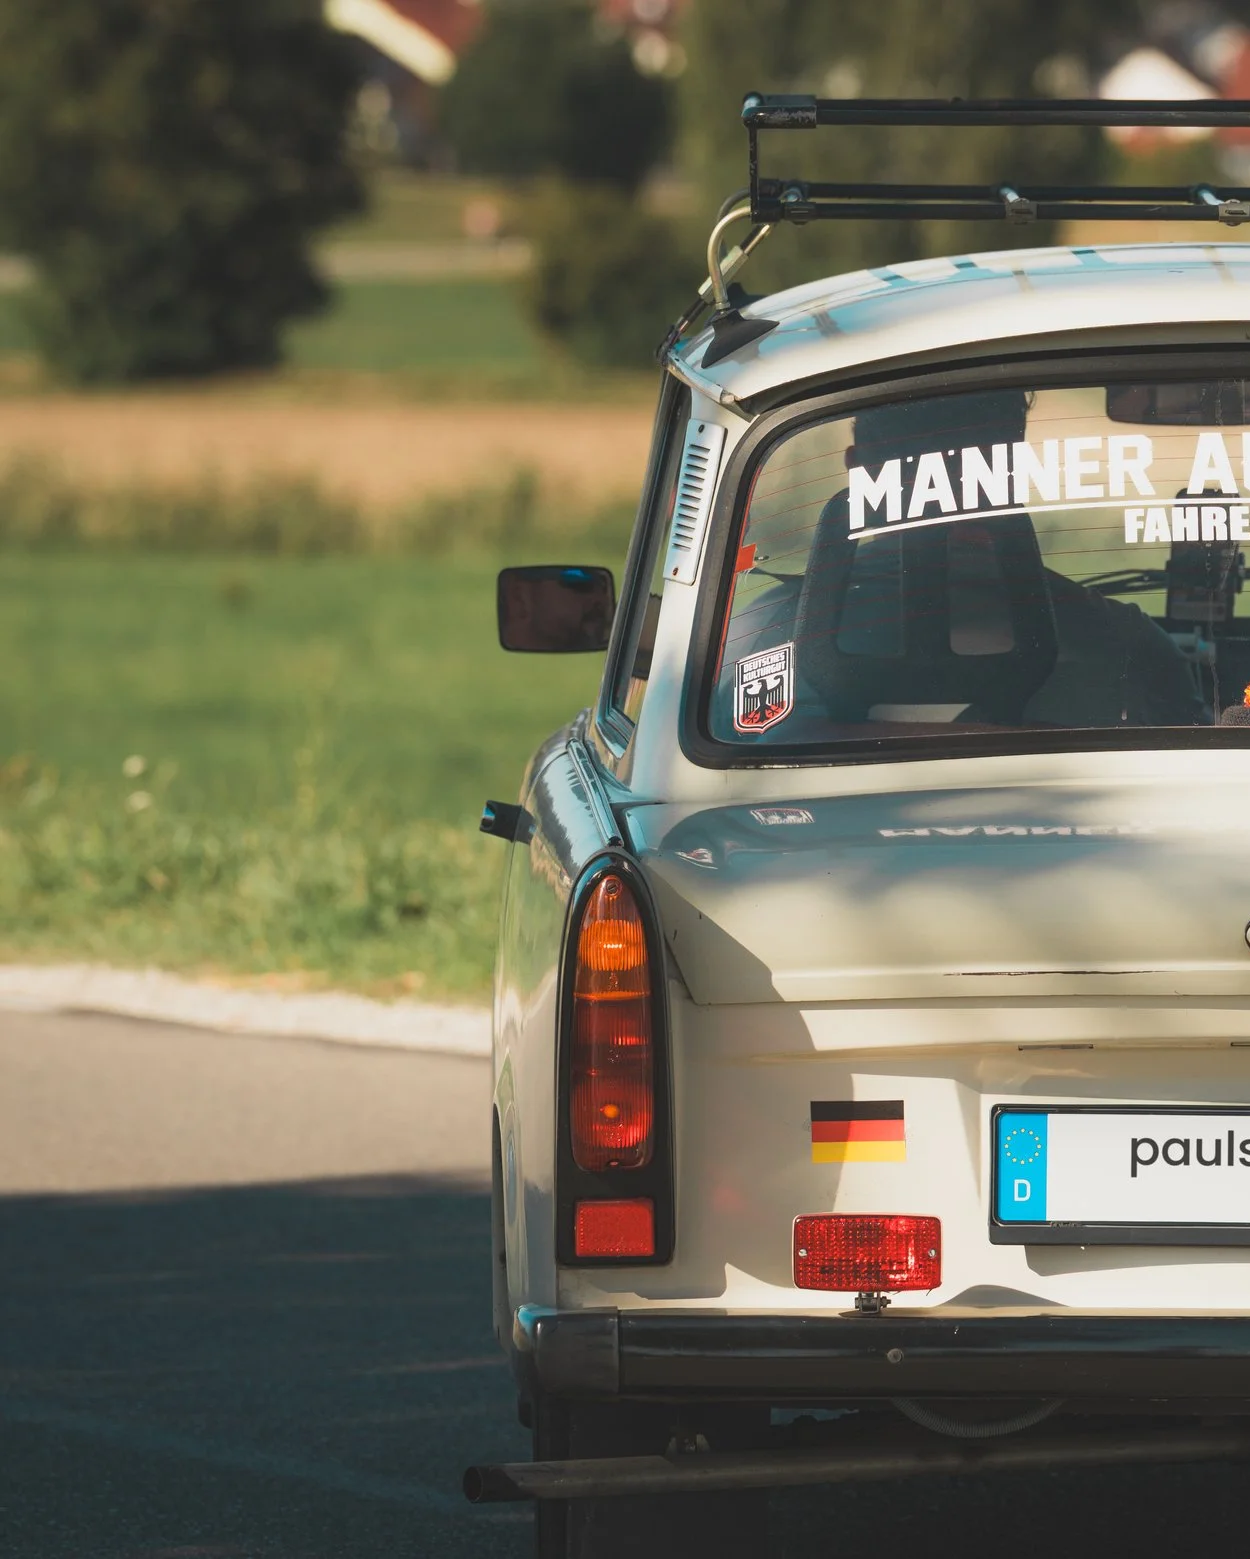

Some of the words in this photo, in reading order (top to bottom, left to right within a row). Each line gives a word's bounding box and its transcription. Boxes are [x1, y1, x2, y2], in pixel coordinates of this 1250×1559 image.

[848, 434, 1156, 531] MÄNNER
[743, 651, 785, 674] DEUTSCHES
[743, 660, 785, 683] KULTURGUT
[1014, 1179, 1031, 1202] D
